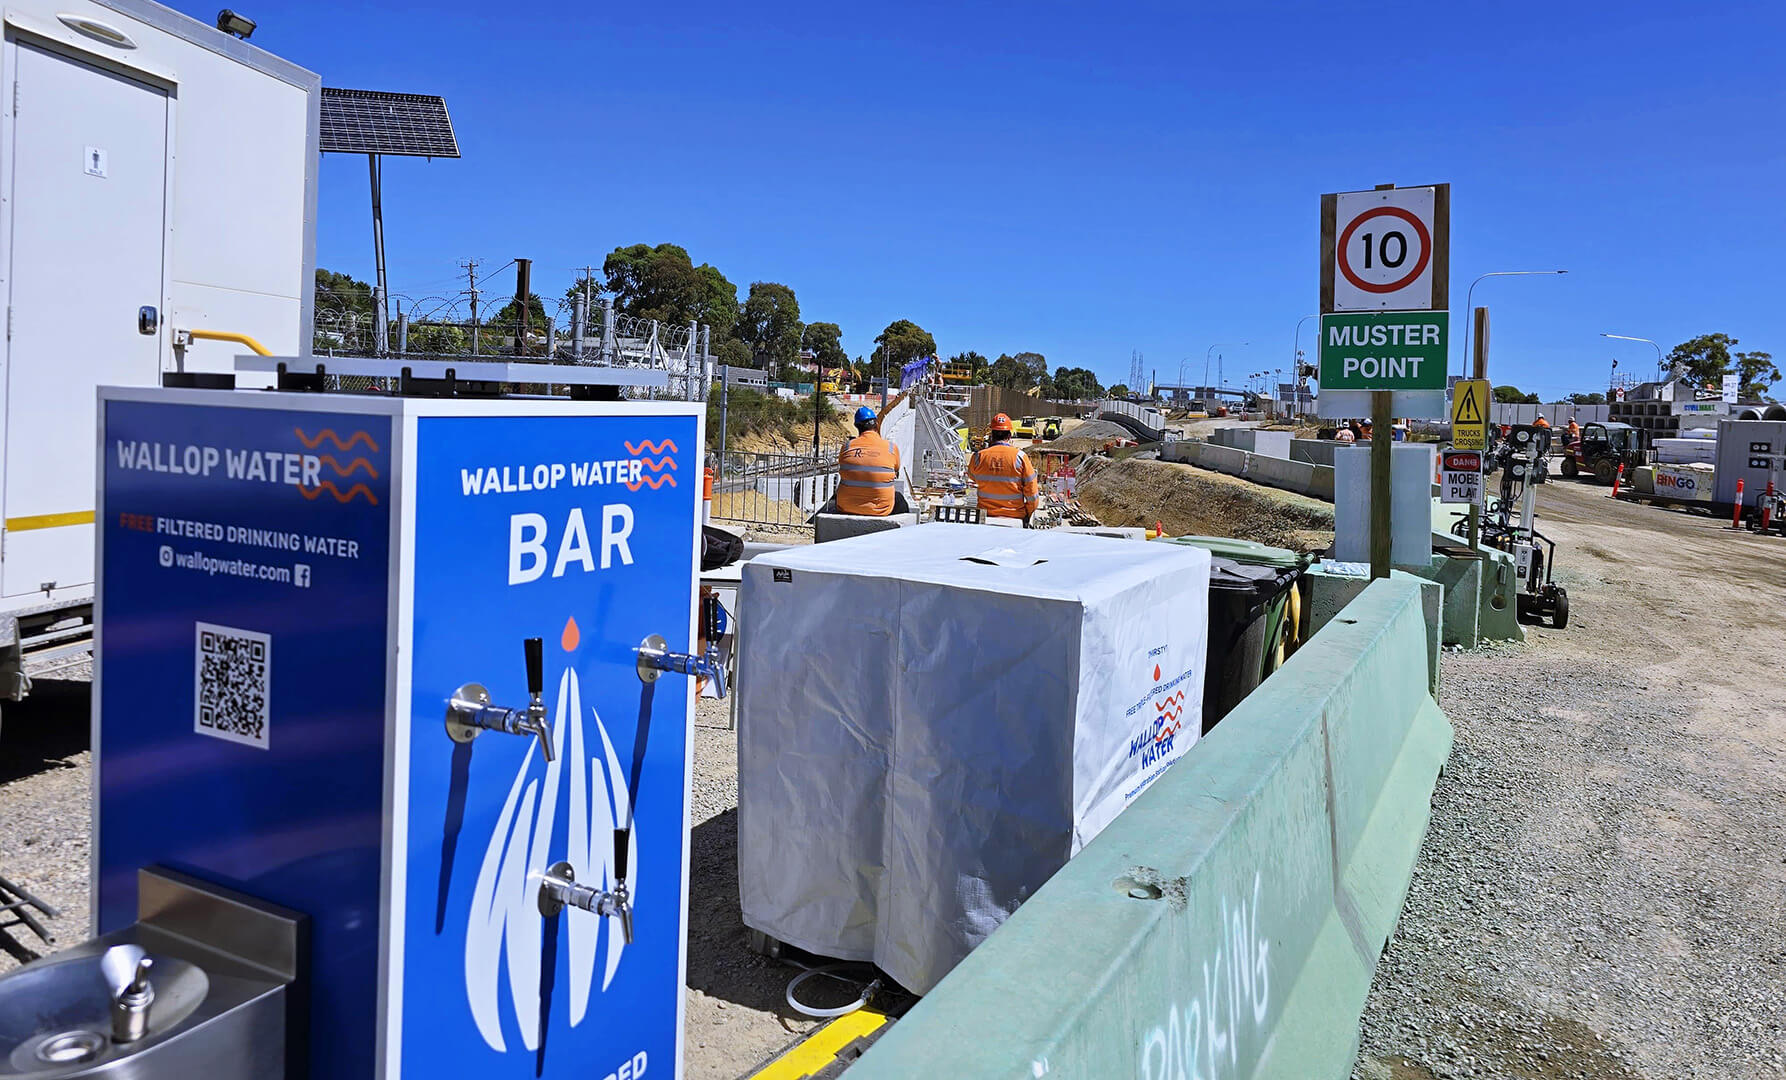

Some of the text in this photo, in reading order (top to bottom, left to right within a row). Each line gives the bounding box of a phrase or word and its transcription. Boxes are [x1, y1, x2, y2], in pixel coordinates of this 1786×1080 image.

[1362, 231, 1408, 269] 10
[1329, 324, 1440, 347] MUSTER
[1343, 357, 1424, 378] POINT
[1454, 438, 1484, 446] CROSSING
[1457, 429, 1480, 437] TRUCKS
[117, 440, 321, 487] WALLOP WATER
[461, 460, 643, 496] WALLOP WATER
[1656, 473, 1695, 489] BINGO
[119, 513, 359, 559] FREE FILTERED DRINKING WATER
[508, 503, 634, 586] BAR
[175, 551, 290, 583] wallopwater.com
[1129, 716, 1165, 758] WALLOP
[1142, 734, 1175, 770] WATER
[603, 1050, 648, 1080] ED
